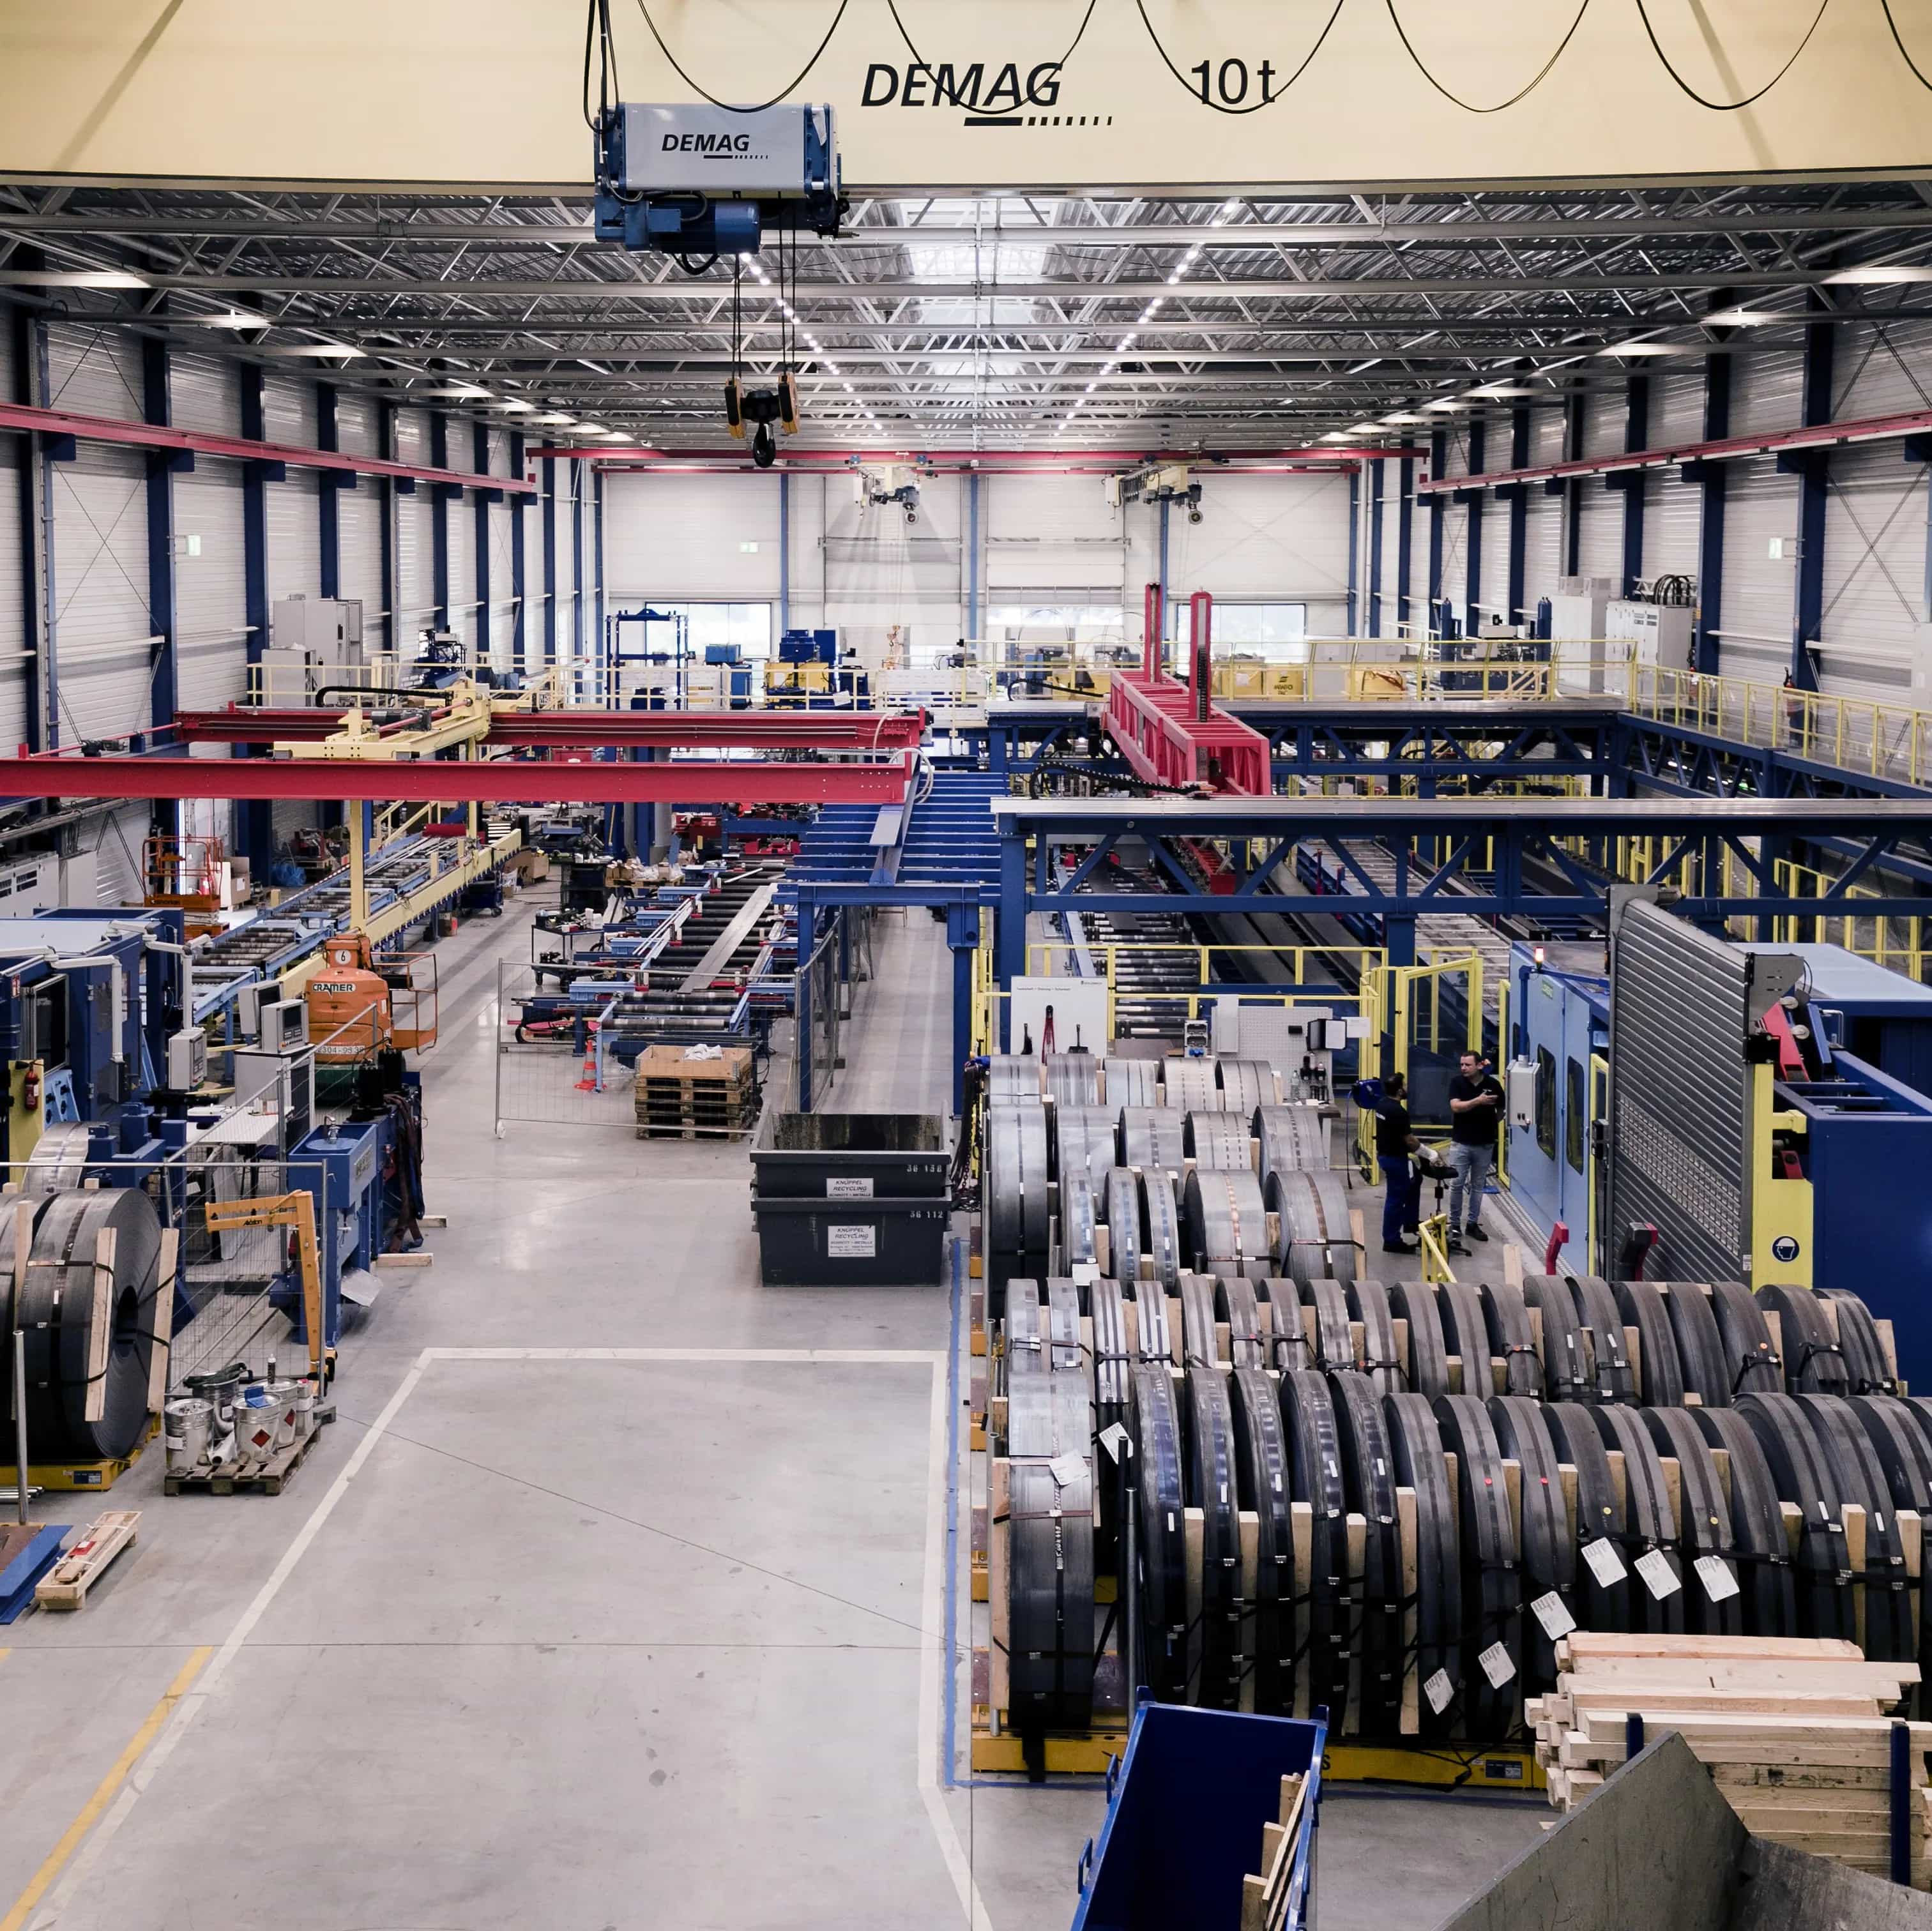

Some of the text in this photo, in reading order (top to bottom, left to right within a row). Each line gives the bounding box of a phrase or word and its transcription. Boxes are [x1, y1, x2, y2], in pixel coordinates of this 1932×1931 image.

[862, 62, 1063, 107] DEMAG
[1191, 58, 1276, 105] 10 t
[662, 134, 750, 151] DEMAG
[341, 951, 346, 962] 6
[313, 984, 353, 993] CRAMER
